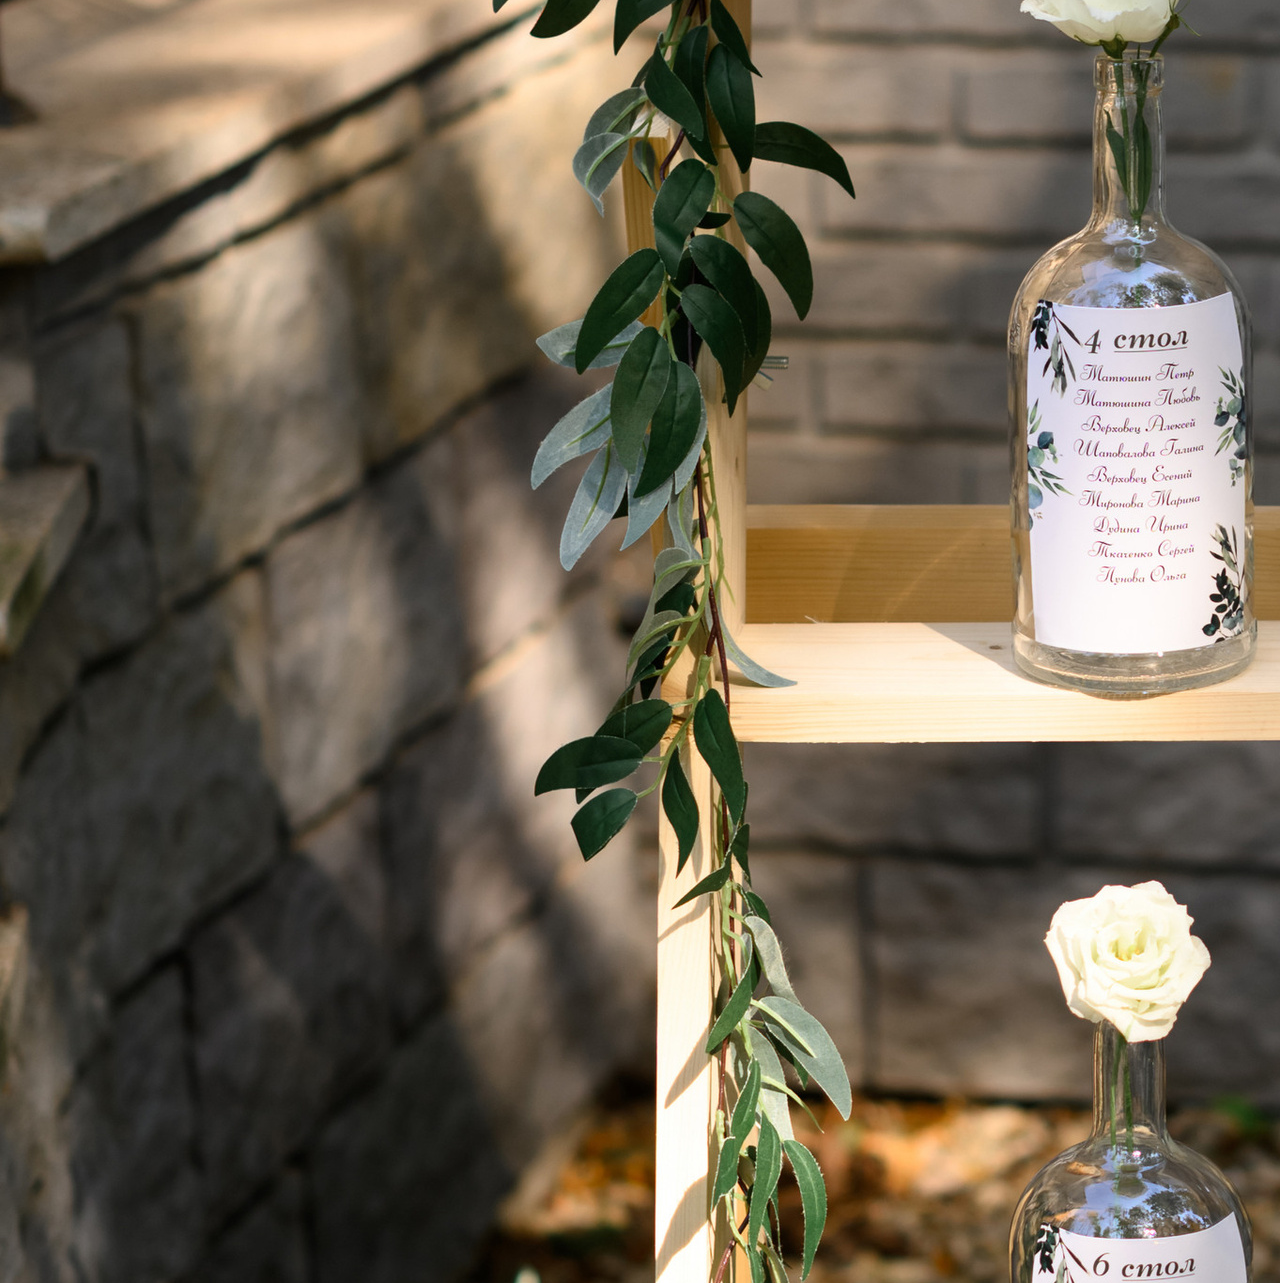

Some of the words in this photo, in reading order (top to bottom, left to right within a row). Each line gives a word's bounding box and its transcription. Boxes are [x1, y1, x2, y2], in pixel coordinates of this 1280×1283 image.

[1085, 329, 1101, 354] 4
[1114, 330, 1188, 349] стол
[1080, 364, 1151, 382] Матюшин
[1155, 362, 1194, 382] Петр
[1074, 388, 1151, 407] Матюшина
[1154, 386, 1200, 406] Любовь
[1081, 414, 1141, 434] Верховец
[1145, 414, 1196, 432] Алексей
[1073, 439, 1155, 458] Шаповалова
[1160, 438, 1204, 456] Галина
[1087, 465, 1147, 485] Верховец
[1152, 465, 1192, 482] Есений
[1079, 490, 1144, 509] Миронова
[1147, 489, 1200, 508] Марина
[1093, 516, 1140, 535] Дудина
[1145, 515, 1189, 534] Ирина
[1088, 541, 1153, 558] Ткаченко
[1157, 539, 1195, 557] Сергей
[1096, 566, 1145, 585] Лунова
[1150, 564, 1187, 582] Ольга
[1093, 1253, 1110, 1276] 6
[1122, 1258, 1196, 1278] стол
